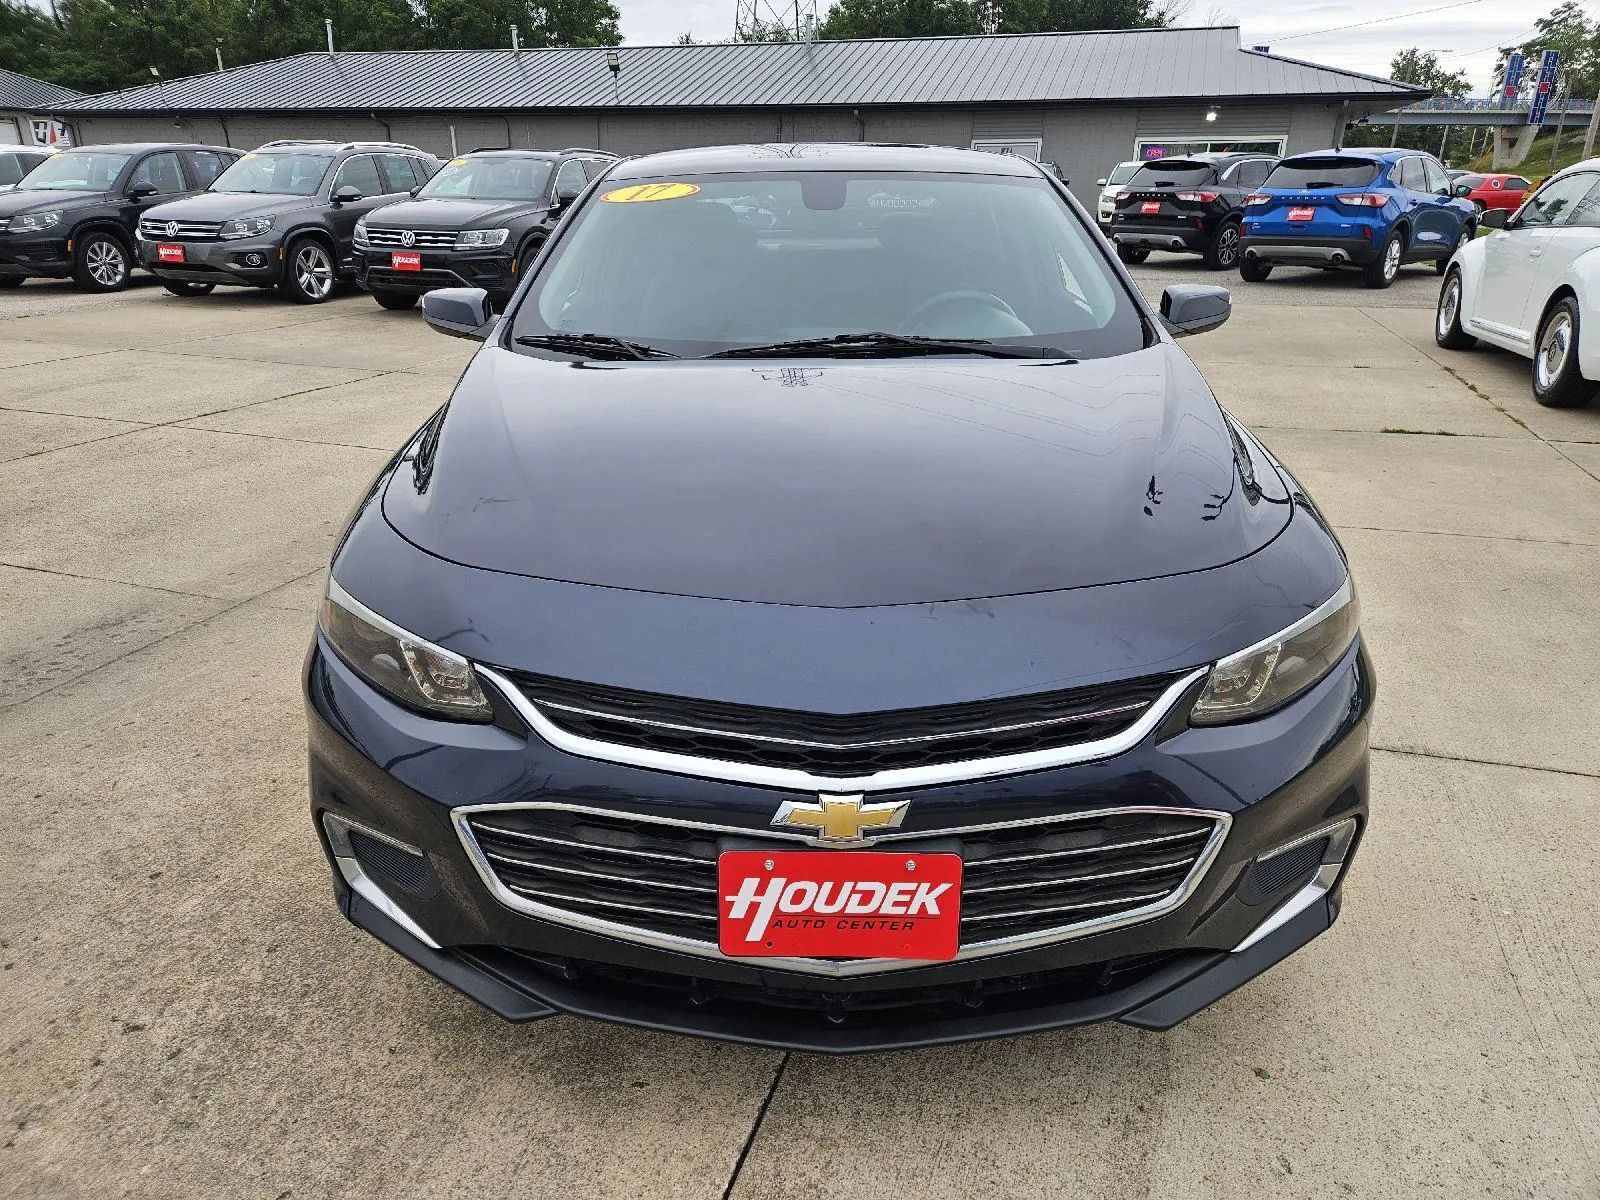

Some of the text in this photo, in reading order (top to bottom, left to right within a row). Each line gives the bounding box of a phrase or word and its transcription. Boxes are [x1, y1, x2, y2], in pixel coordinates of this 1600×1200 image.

[625, 184, 676, 199] 17
[392, 255, 419, 267] HOUDEK
[725, 877, 954, 942] HOUDEK
[772, 919, 916, 931] AUTO CENTER
